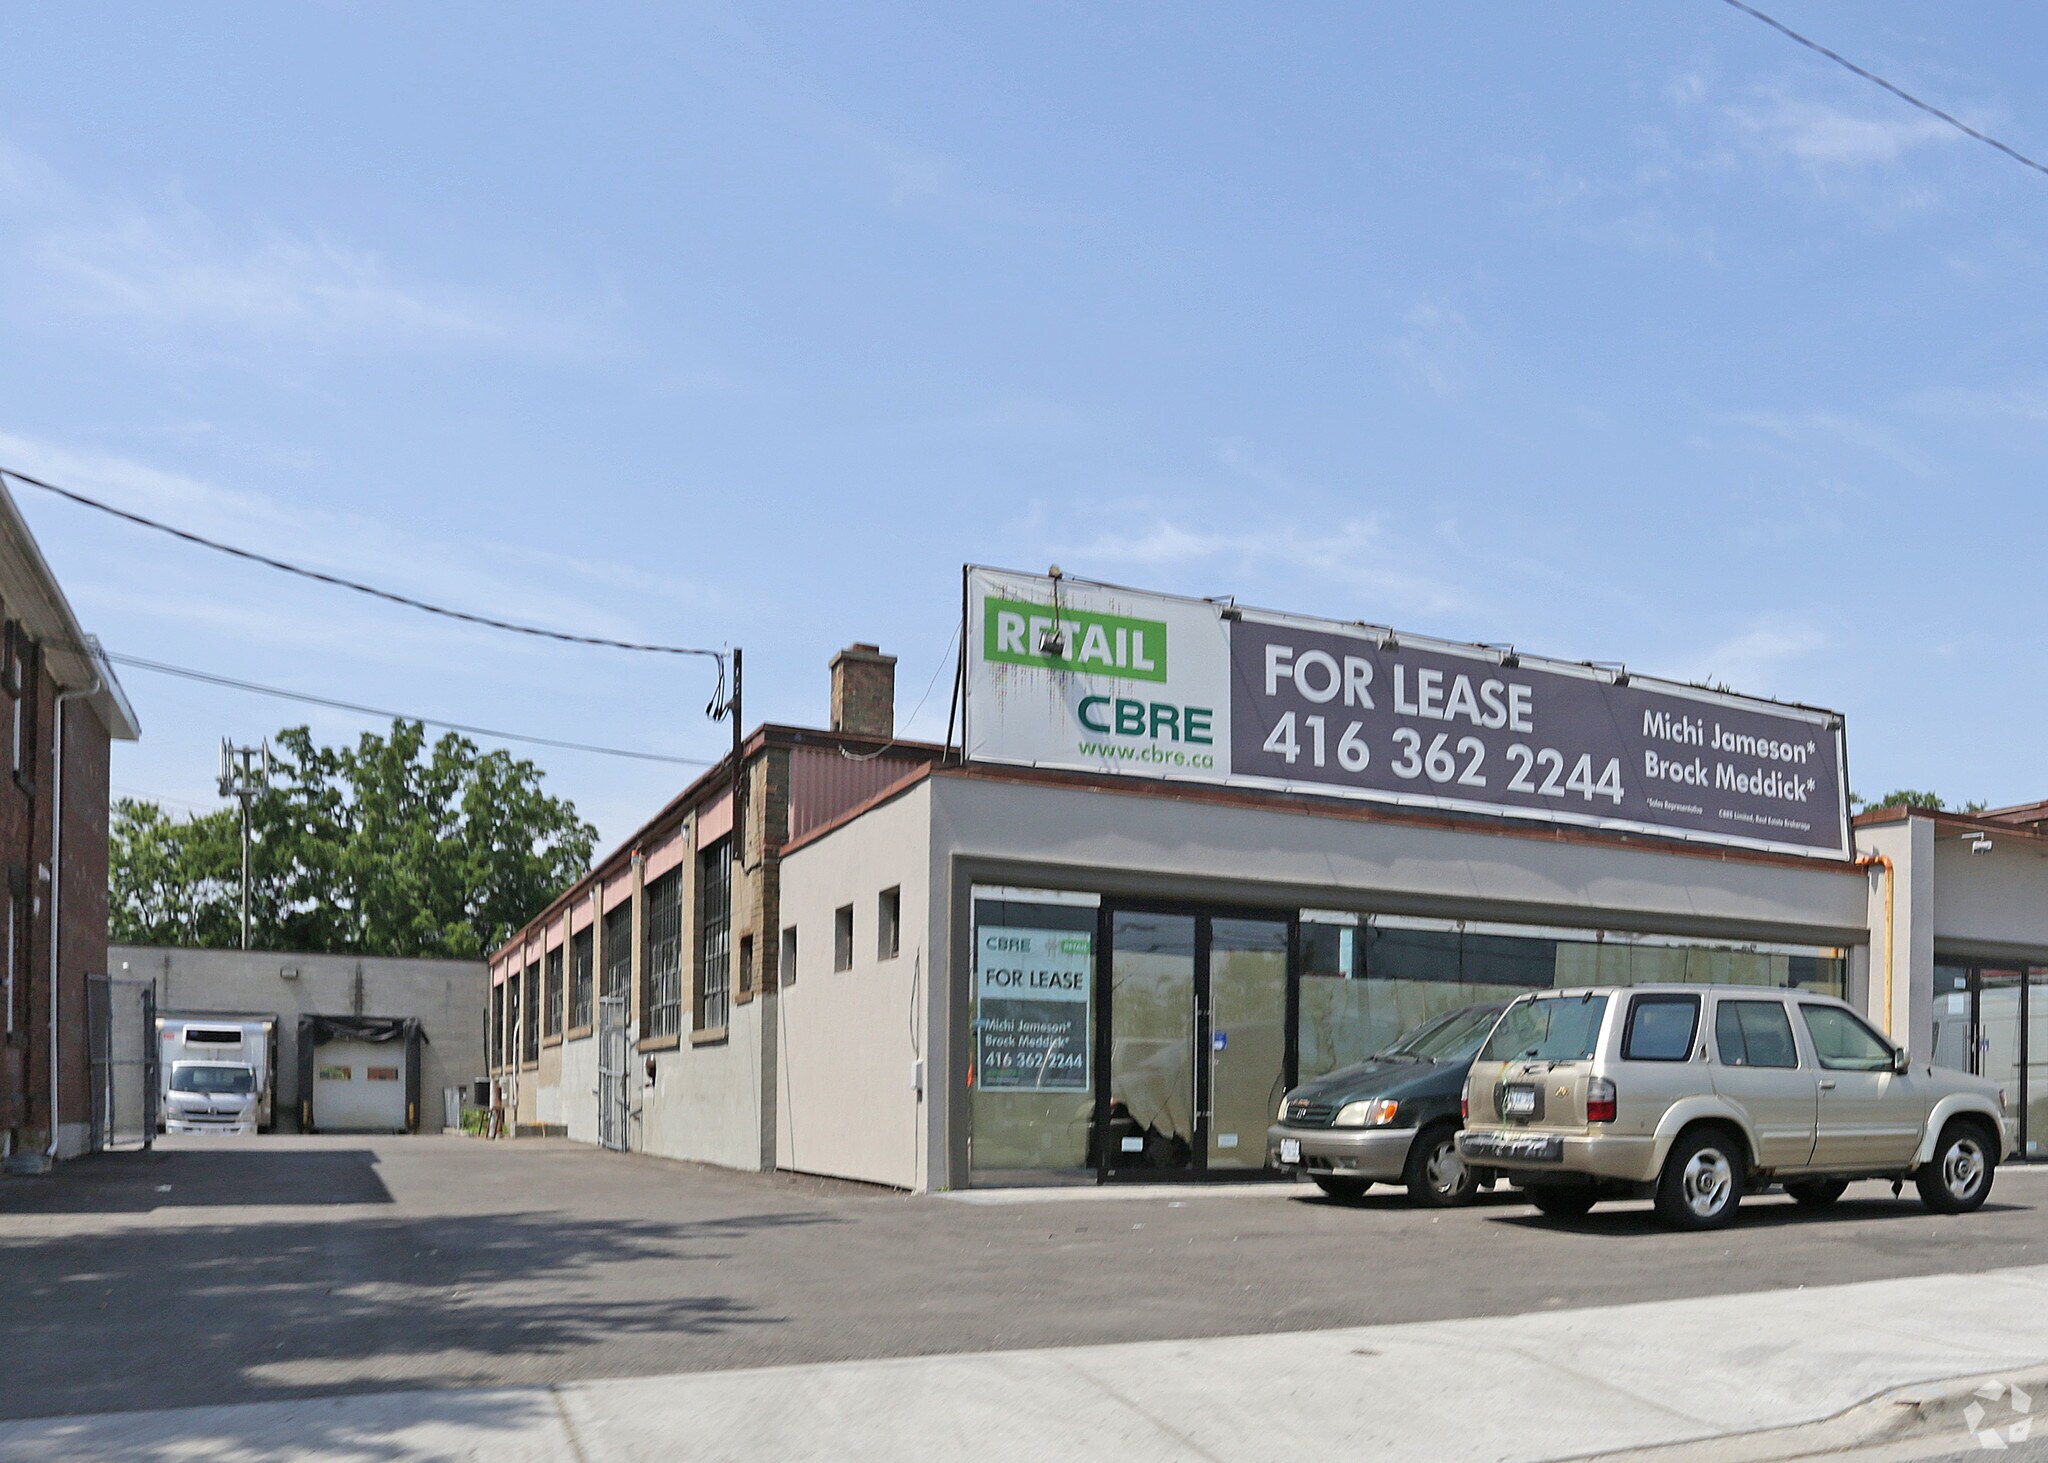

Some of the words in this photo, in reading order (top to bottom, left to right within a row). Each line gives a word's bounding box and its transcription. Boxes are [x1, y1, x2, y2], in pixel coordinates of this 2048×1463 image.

[997, 610, 1155, 672] RETAIL
[1265, 643, 1376, 710] FOR
[1393, 663, 1533, 734] LEASE
[1078, 695, 1213, 745] CBRE
[1642, 709, 1704, 746] Michi
[1078, 740, 1214, 769] www.cbre.ca
[1262, 710, 1371, 773] 416
[1390, 727, 1487, 788] 362
[1506, 743, 1625, 805] 2244
[1644, 749, 1709, 787] Brock
[986, 936, 1031, 953] CBRE
[985, 968, 1023, 988] FOR
[1030, 971, 1083, 990] LEASE
[985, 1018, 1015, 1032] Michi
[985, 1034, 1015, 1047] Brock
[985, 1051, 1012, 1067] 416
[1016, 1052, 1043, 1068] 362
[1049, 1052, 1082, 1068] 2244
